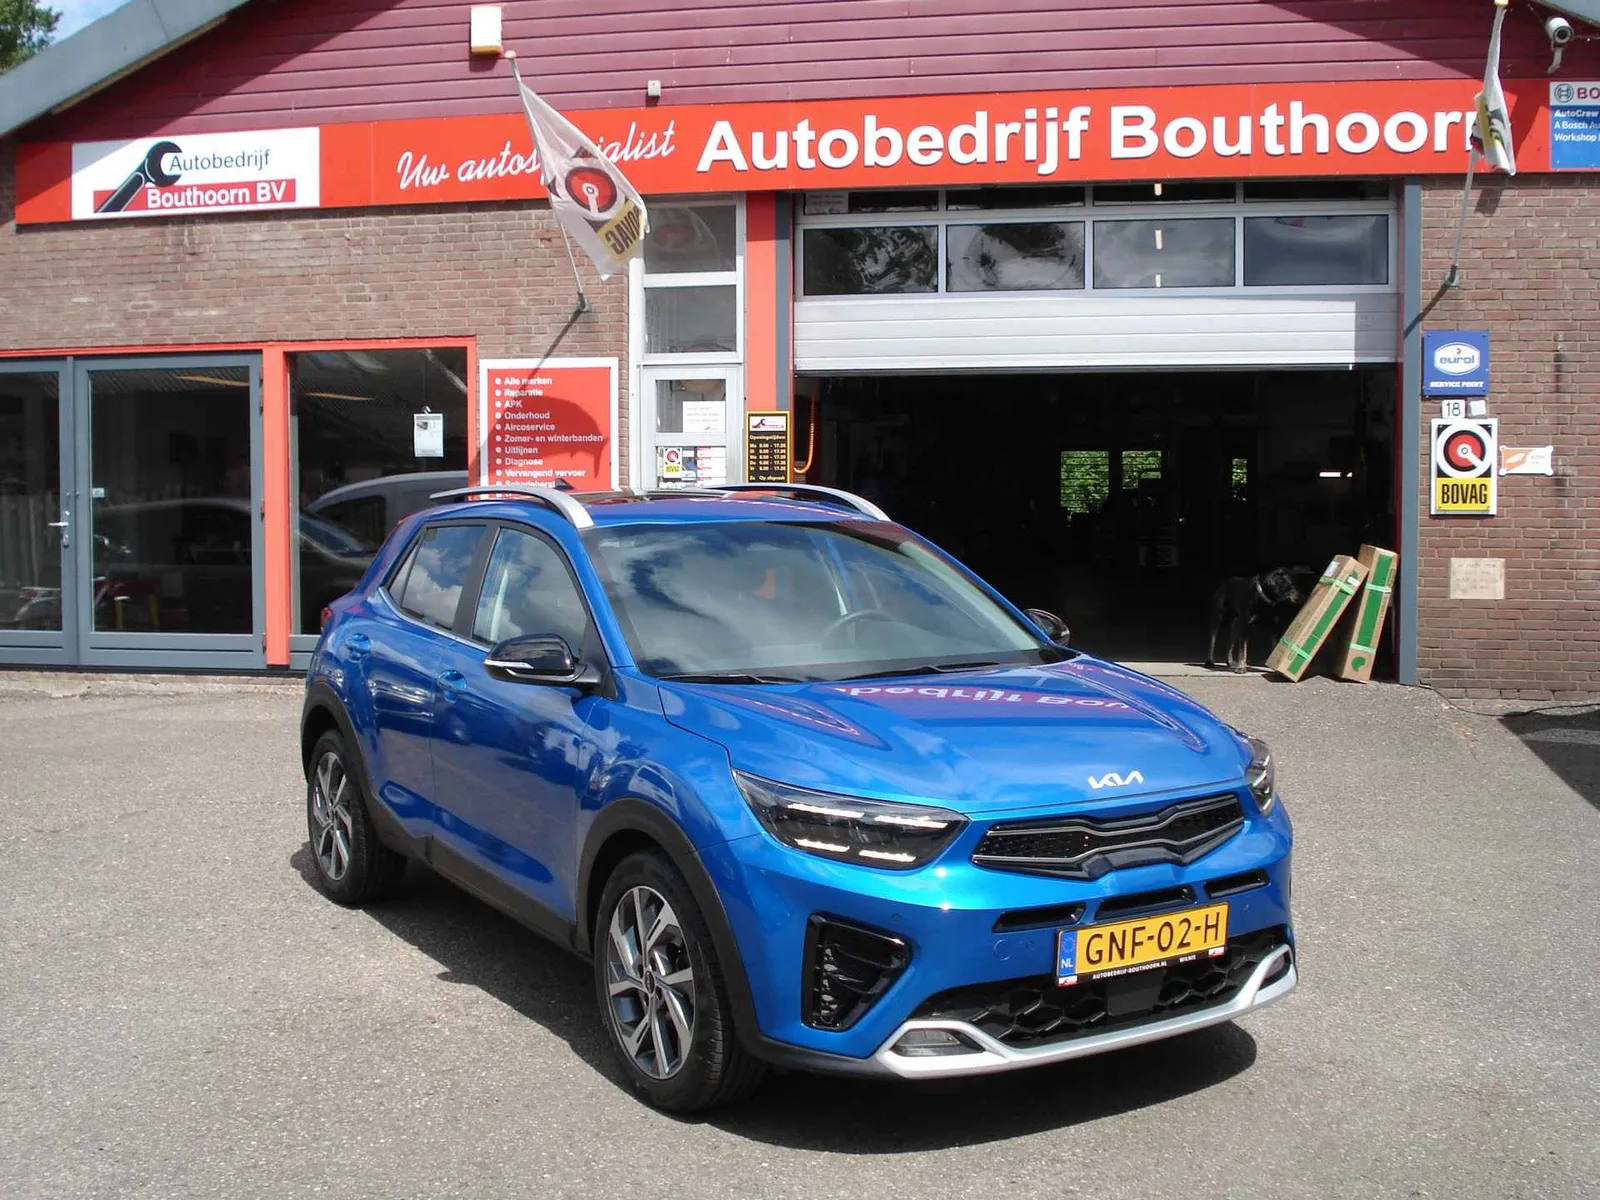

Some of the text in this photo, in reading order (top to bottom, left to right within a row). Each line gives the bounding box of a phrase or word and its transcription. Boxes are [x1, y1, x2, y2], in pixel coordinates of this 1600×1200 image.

[1554, 109, 1599, 118] AutoCrew
[1554, 121, 1561, 129] A
[1562, 121, 1589, 130] Bosch
[696, 105, 1092, 175] Autobedrijf
[1554, 132, 1598, 143] Workshop
[169, 149, 271, 172] Autobedrijf
[396, 151, 450, 190] Uw
[147, 181, 287, 209] Bouthoorn BV
[1439, 354, 1475, 365] eurol
[504, 377, 553, 385] Alle merken
[504, 388, 544, 398] Reparatie
[504, 400, 523, 408] APK
[504, 410, 551, 419] Onderhoud
[1446, 402, 1462, 417] 18
[504, 422, 556, 431] Aircoservice
[547, 433, 603, 442] winterbanden
[504, 446, 539, 455] Uitlijnen
[504, 458, 543, 467] Diagnose
[505, 469, 587, 478] Vervangend vervoer
[1441, 483, 1487, 504] BOVAG
[1087, 770, 1144, 789] KIA
[1085, 911, 1221, 966] GNF-02-H
[1061, 957, 1074, 969] NL
